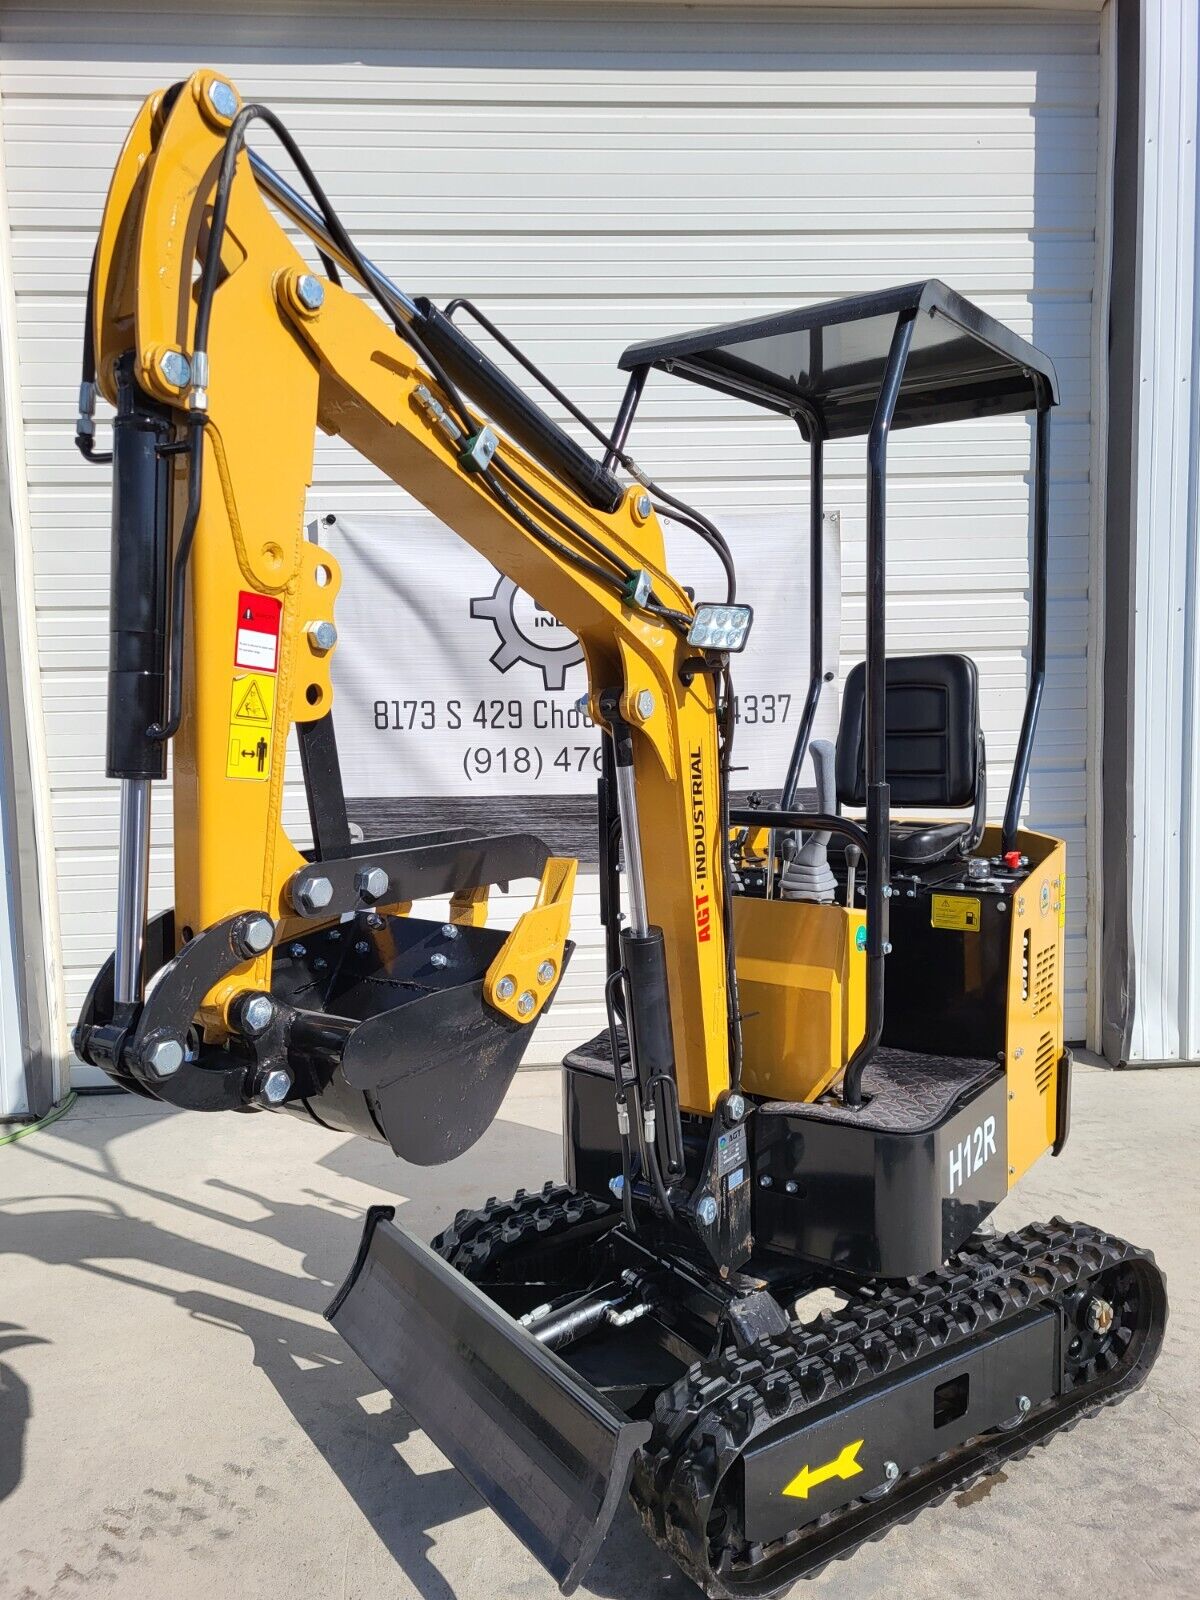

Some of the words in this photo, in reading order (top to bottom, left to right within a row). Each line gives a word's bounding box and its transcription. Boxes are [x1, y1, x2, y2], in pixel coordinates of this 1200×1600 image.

[373, 699, 436, 730] 8173
[446, 699, 462, 730] S
[472, 699, 523, 729] 429
[463, 746, 543, 781] (918)
[690, 746, 707, 880] INDUSTRIAL
[695, 894, 711, 943] AGT
[728, 1128, 742, 1142] AGT
[949, 1115, 997, 1195] H12R
